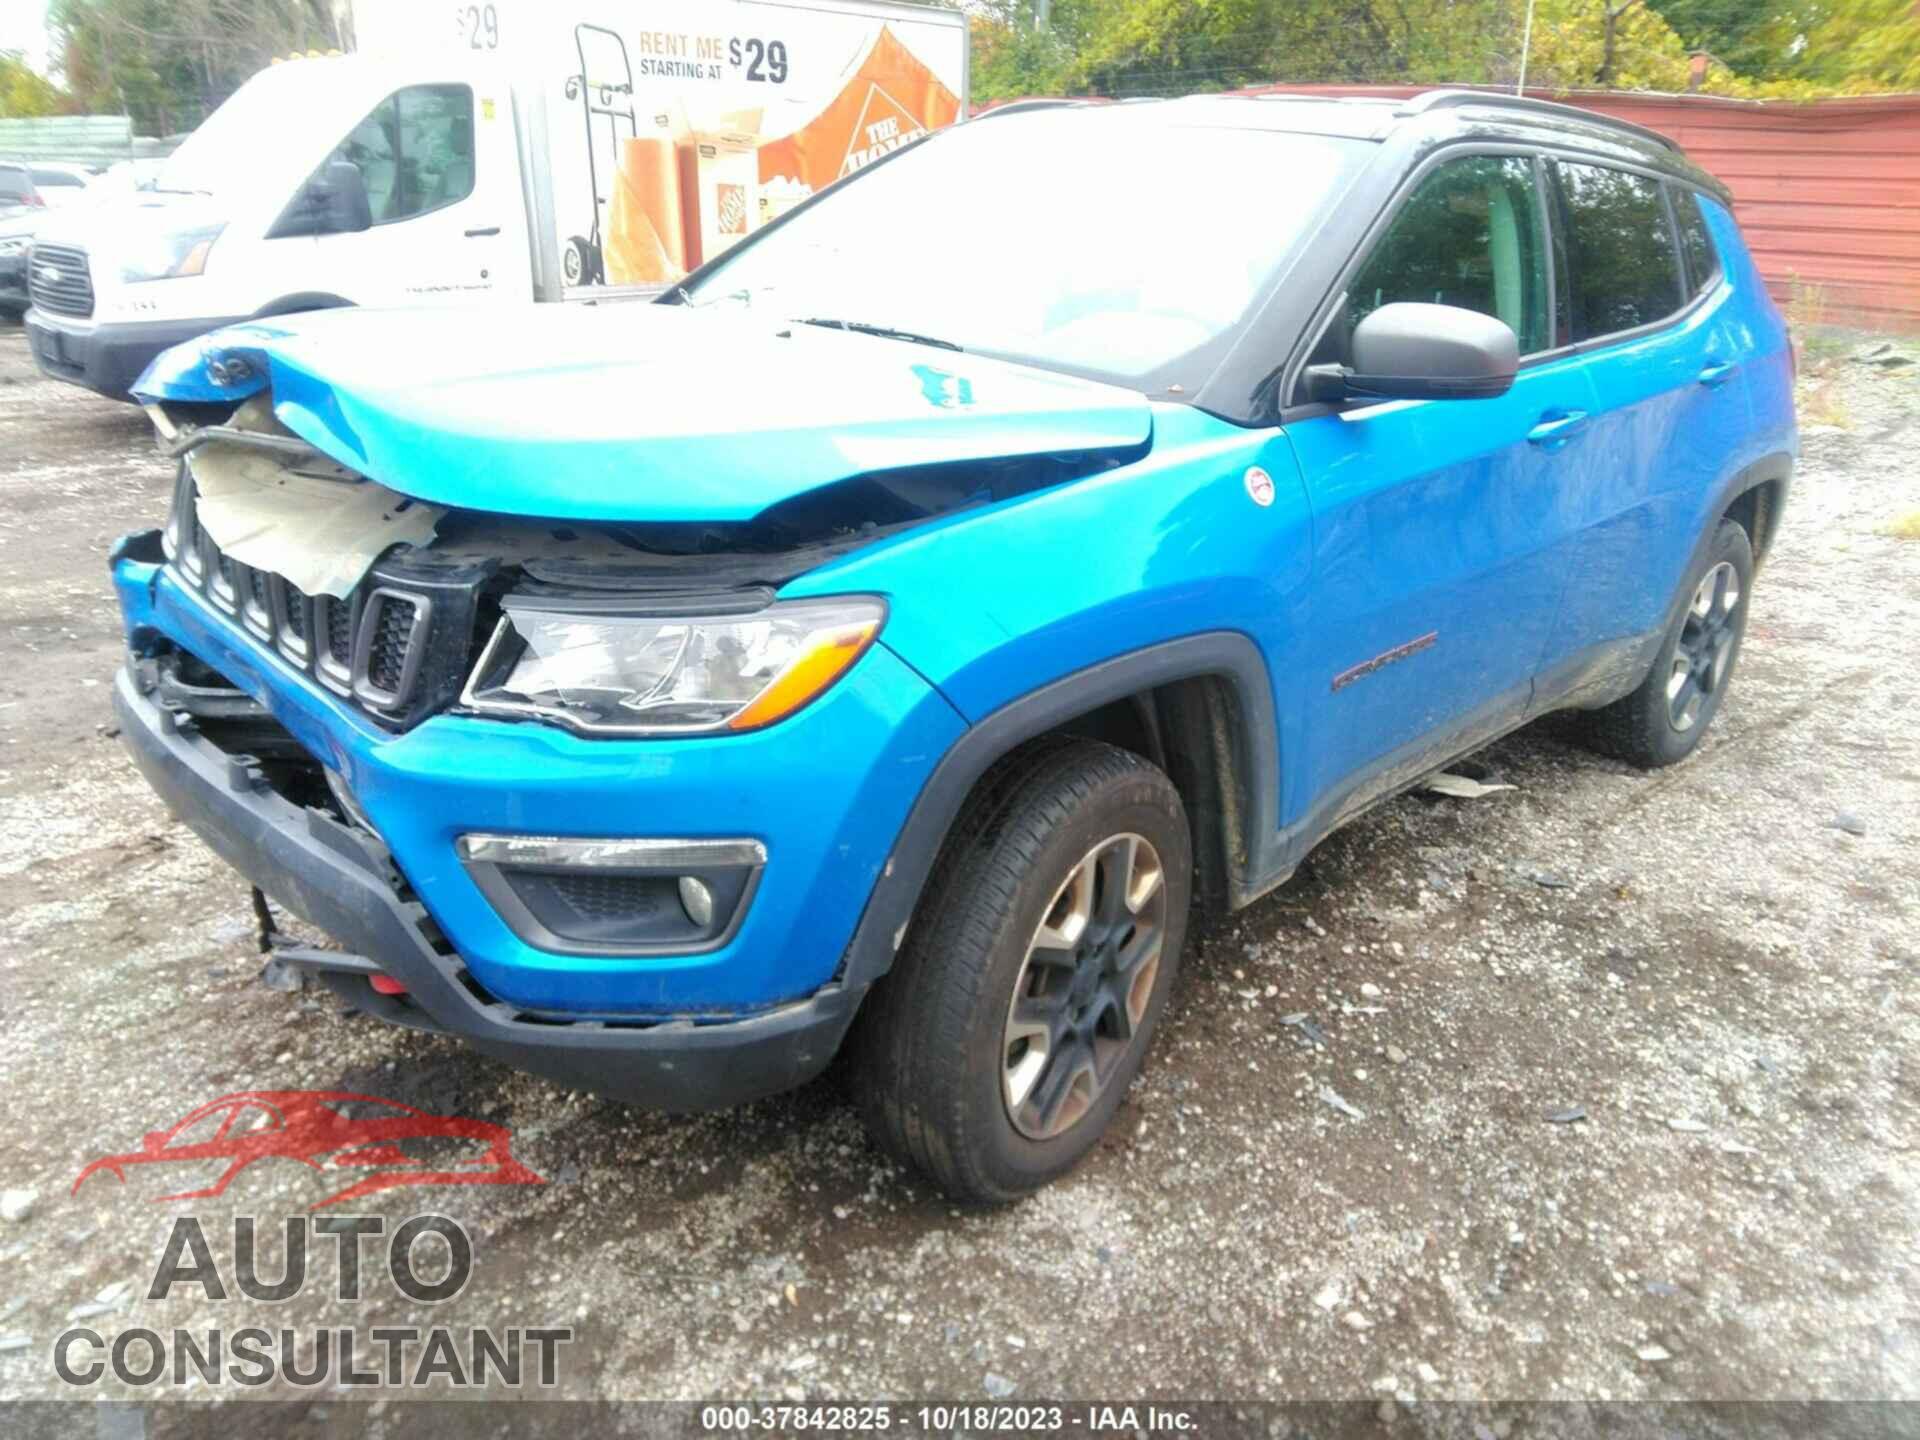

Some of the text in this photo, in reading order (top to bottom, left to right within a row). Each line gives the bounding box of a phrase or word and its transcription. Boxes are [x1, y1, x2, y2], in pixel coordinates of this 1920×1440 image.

[640, 31, 788, 84] RENT ME $29
[640, 58, 722, 80] STARTING AT
[866, 116, 899, 145] THE
